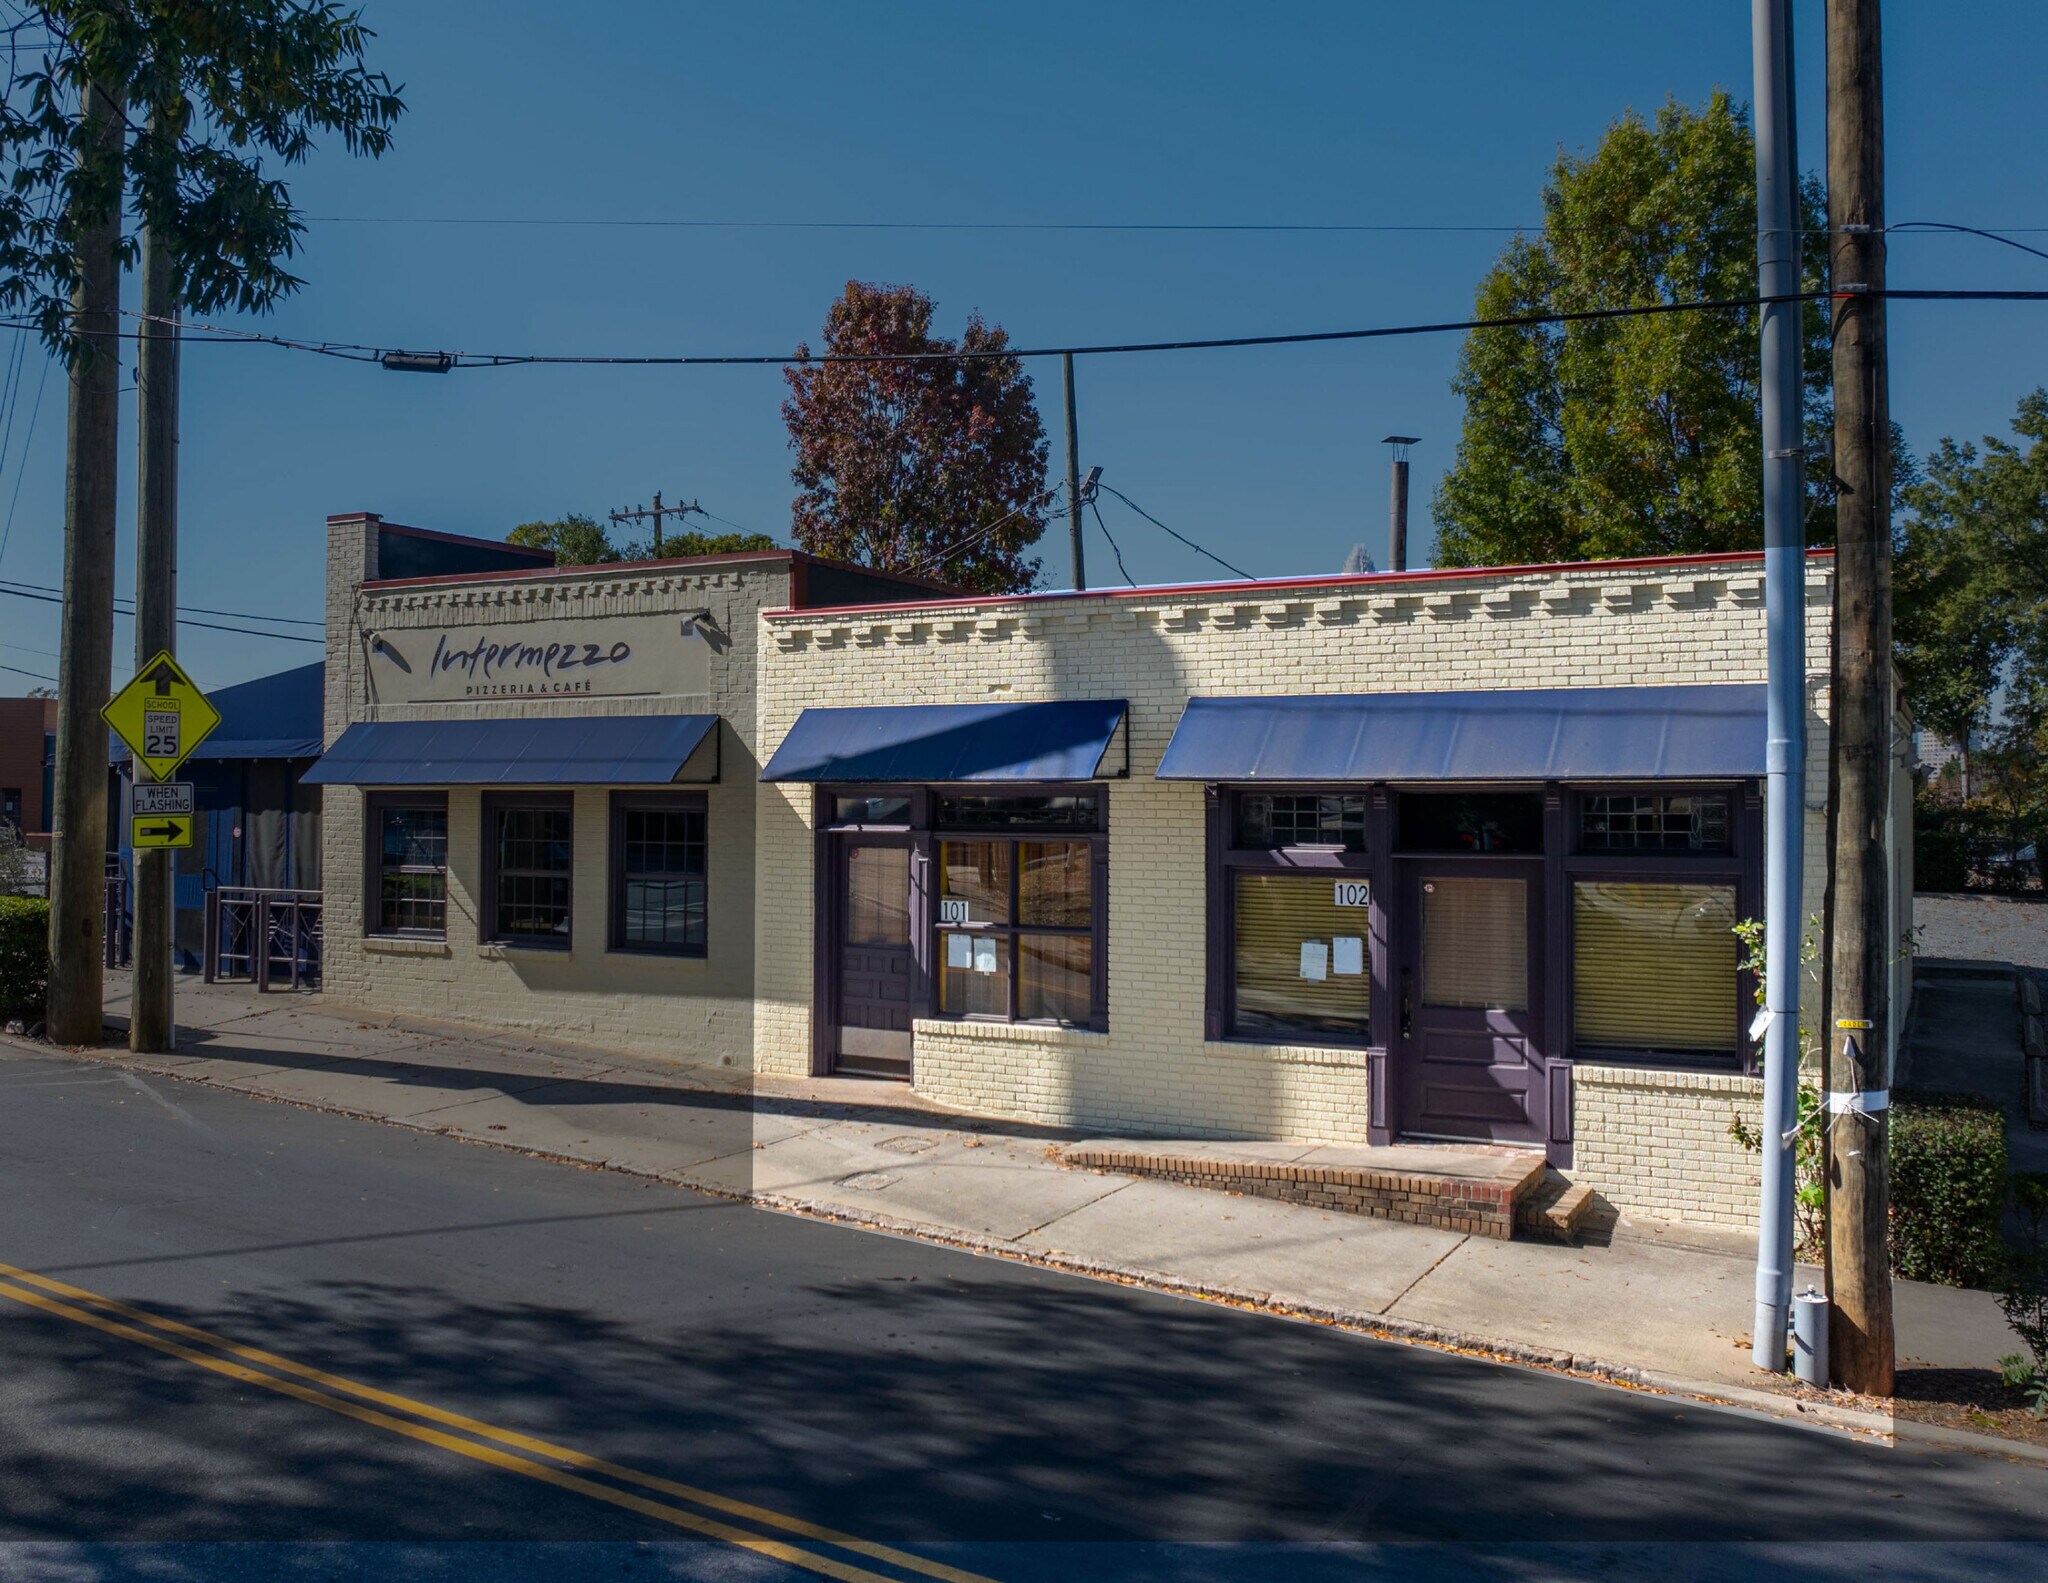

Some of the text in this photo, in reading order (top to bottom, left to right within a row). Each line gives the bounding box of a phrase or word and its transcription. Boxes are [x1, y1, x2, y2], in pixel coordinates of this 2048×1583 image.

[430, 634, 631, 679] Intermezzo
[466, 679, 591, 695] PIZZERIA & CAFÉ
[146, 700, 179, 710] SCHOOL
[147, 715, 178, 724] SPEED
[150, 725, 174, 734] LIMIT
[146, 735, 177, 754] 25
[146, 787, 179, 799] WHEN
[135, 799, 190, 811] FLASHING
[1337, 884, 1368, 905] 102
[943, 902, 966, 920] 101
